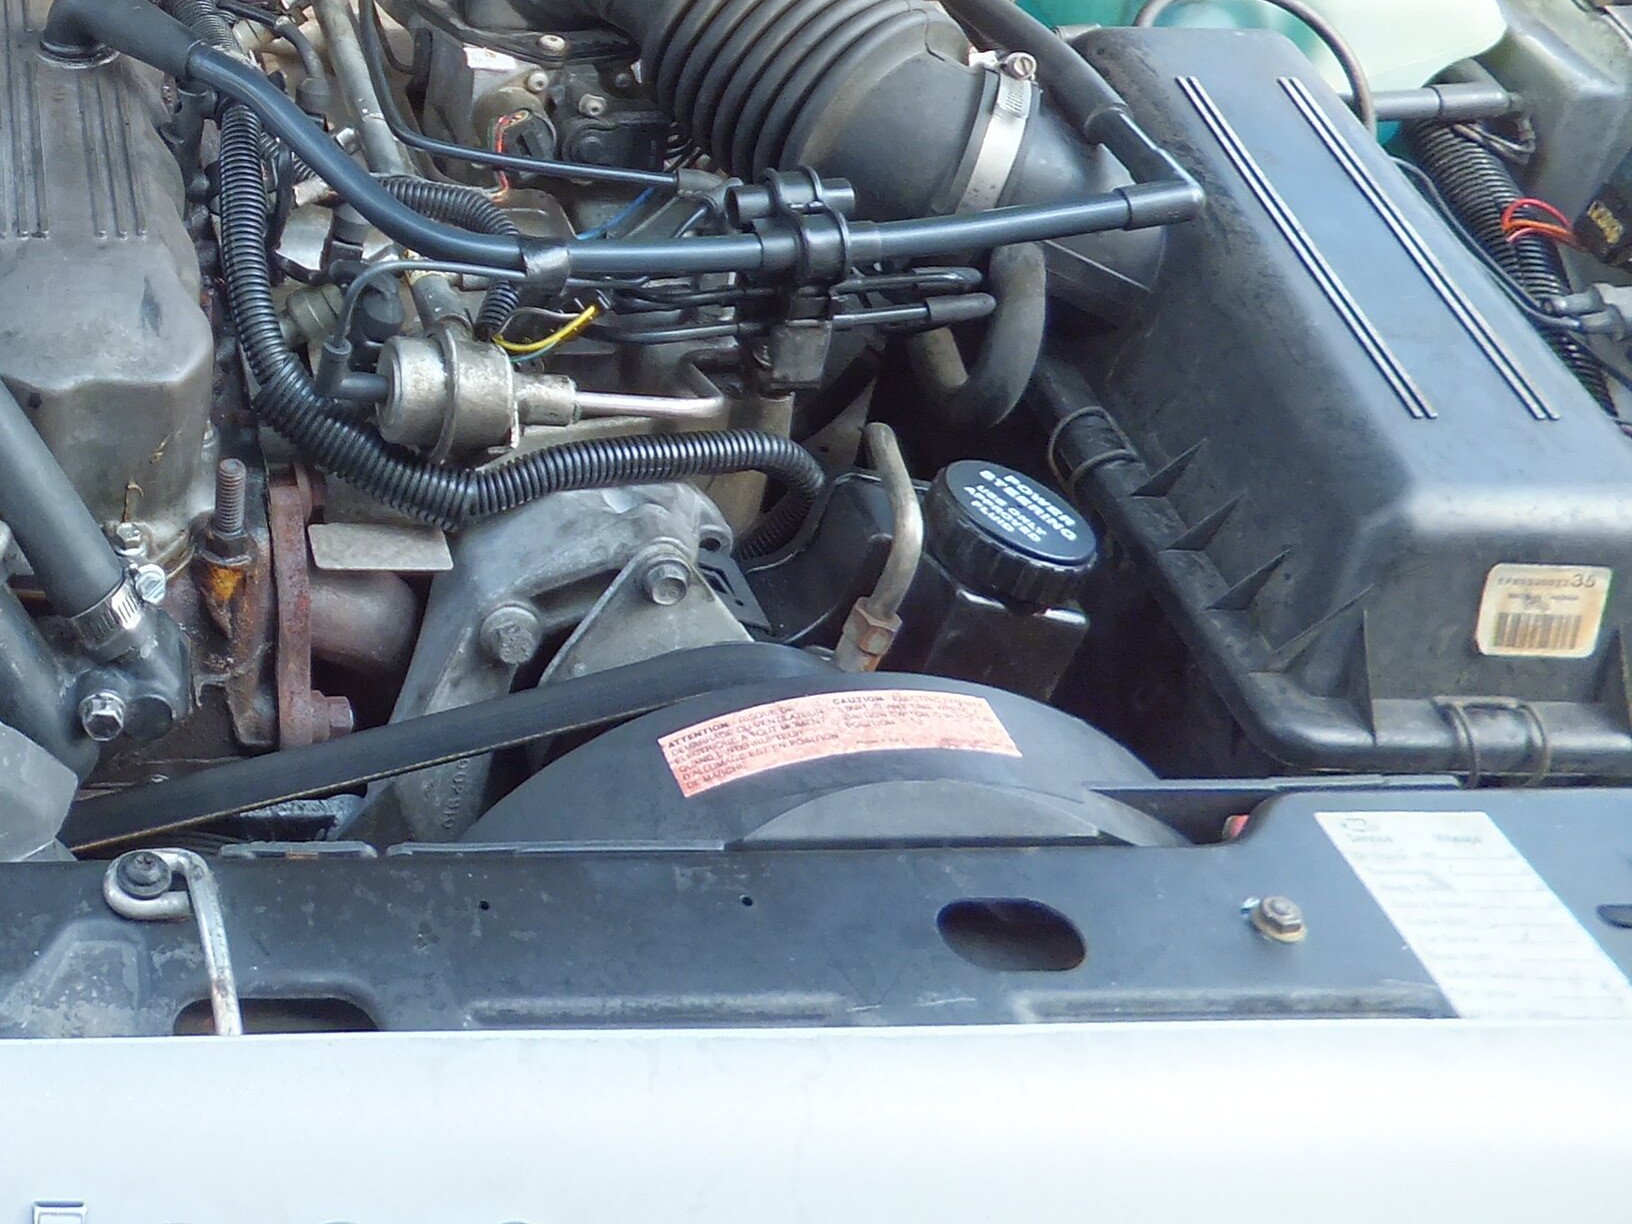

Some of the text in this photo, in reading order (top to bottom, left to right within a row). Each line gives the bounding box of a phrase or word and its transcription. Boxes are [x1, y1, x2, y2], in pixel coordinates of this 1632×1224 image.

[963, 486, 1042, 542] APPROVED
[971, 500, 1014, 532] FLUID
[976, 485, 1047, 536] USE ONLY
[980, 470, 1077, 541] STEERING
[1004, 475, 1075, 526] POWER
[832, 695, 884, 706] CAUTION
[668, 722, 730, 748] ATTENTION
